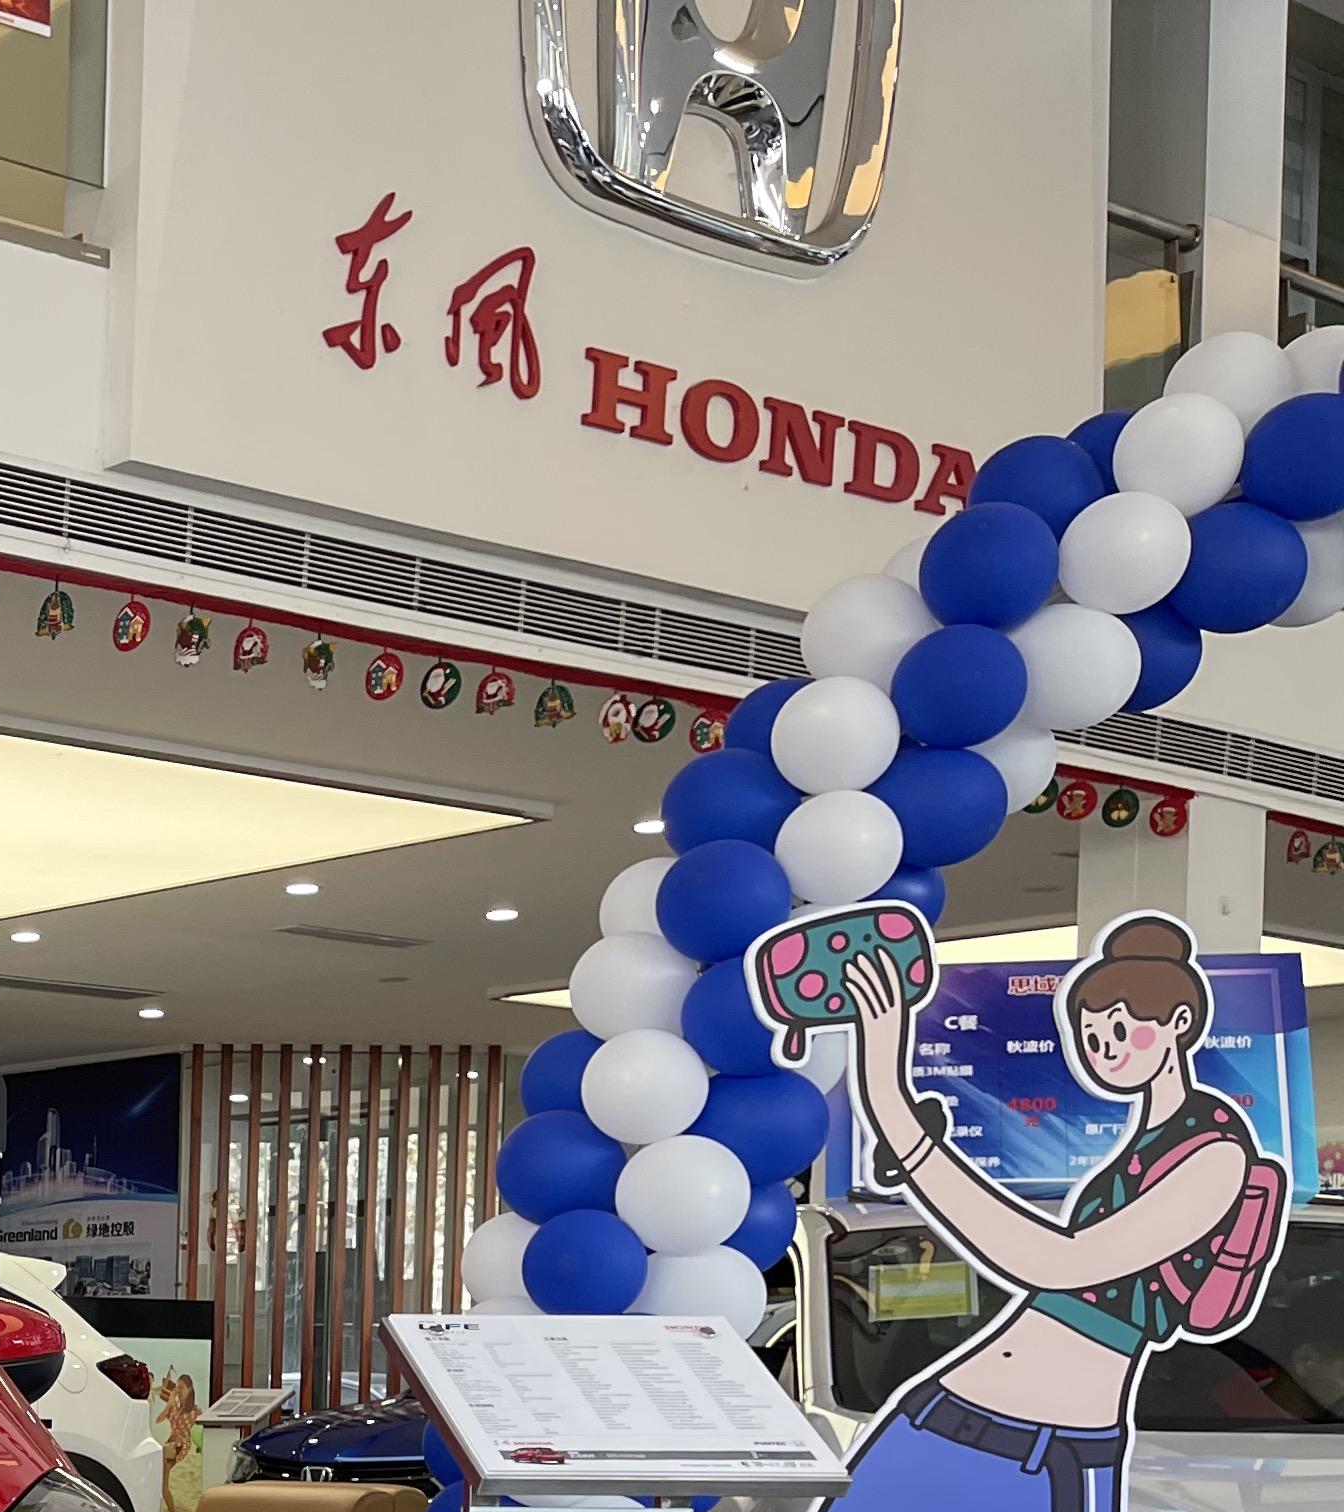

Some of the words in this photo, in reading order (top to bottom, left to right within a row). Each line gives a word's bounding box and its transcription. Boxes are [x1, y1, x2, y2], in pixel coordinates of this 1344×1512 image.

[322, 192, 541, 400] 东风
[580, 347, 981, 516] HONDA
[86, 1221, 135, 1238] 绿地控股
